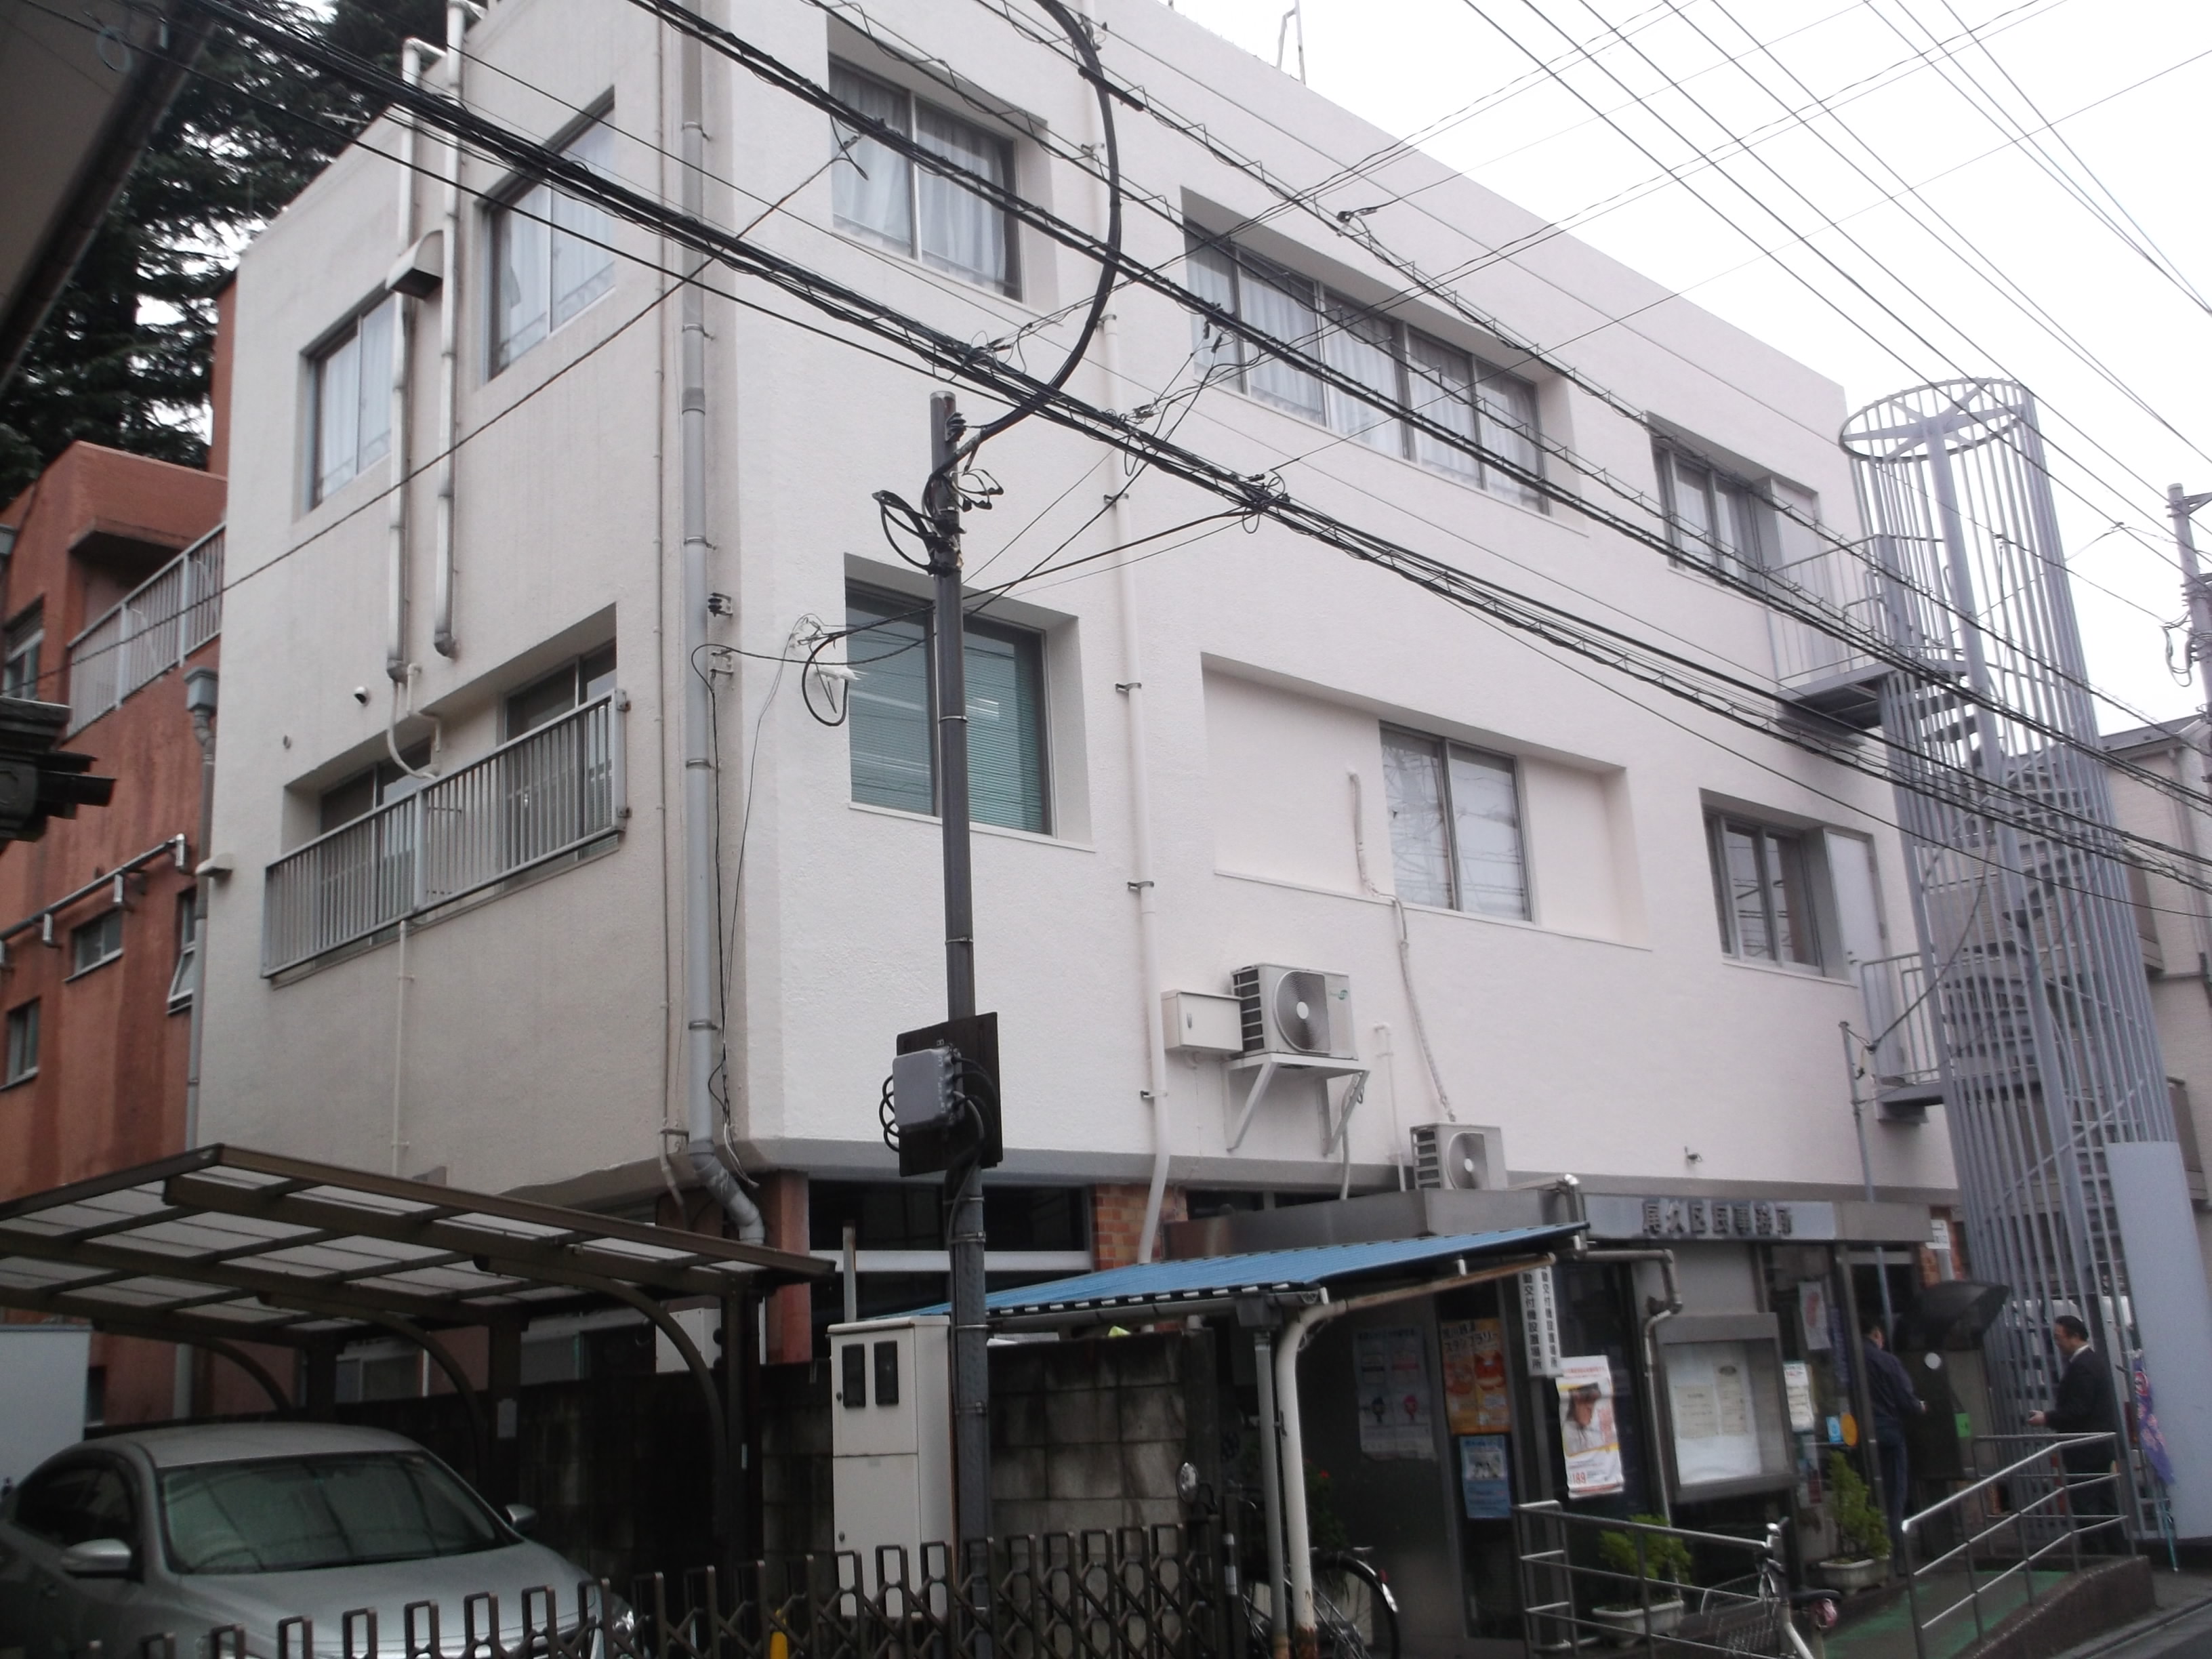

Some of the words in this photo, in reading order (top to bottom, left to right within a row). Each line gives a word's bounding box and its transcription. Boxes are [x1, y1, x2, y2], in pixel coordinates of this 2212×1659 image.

[1642, 1201, 1792, 1236] 尾久区民事務所
[1541, 1267, 1557, 1368] 動交付機設置場所
